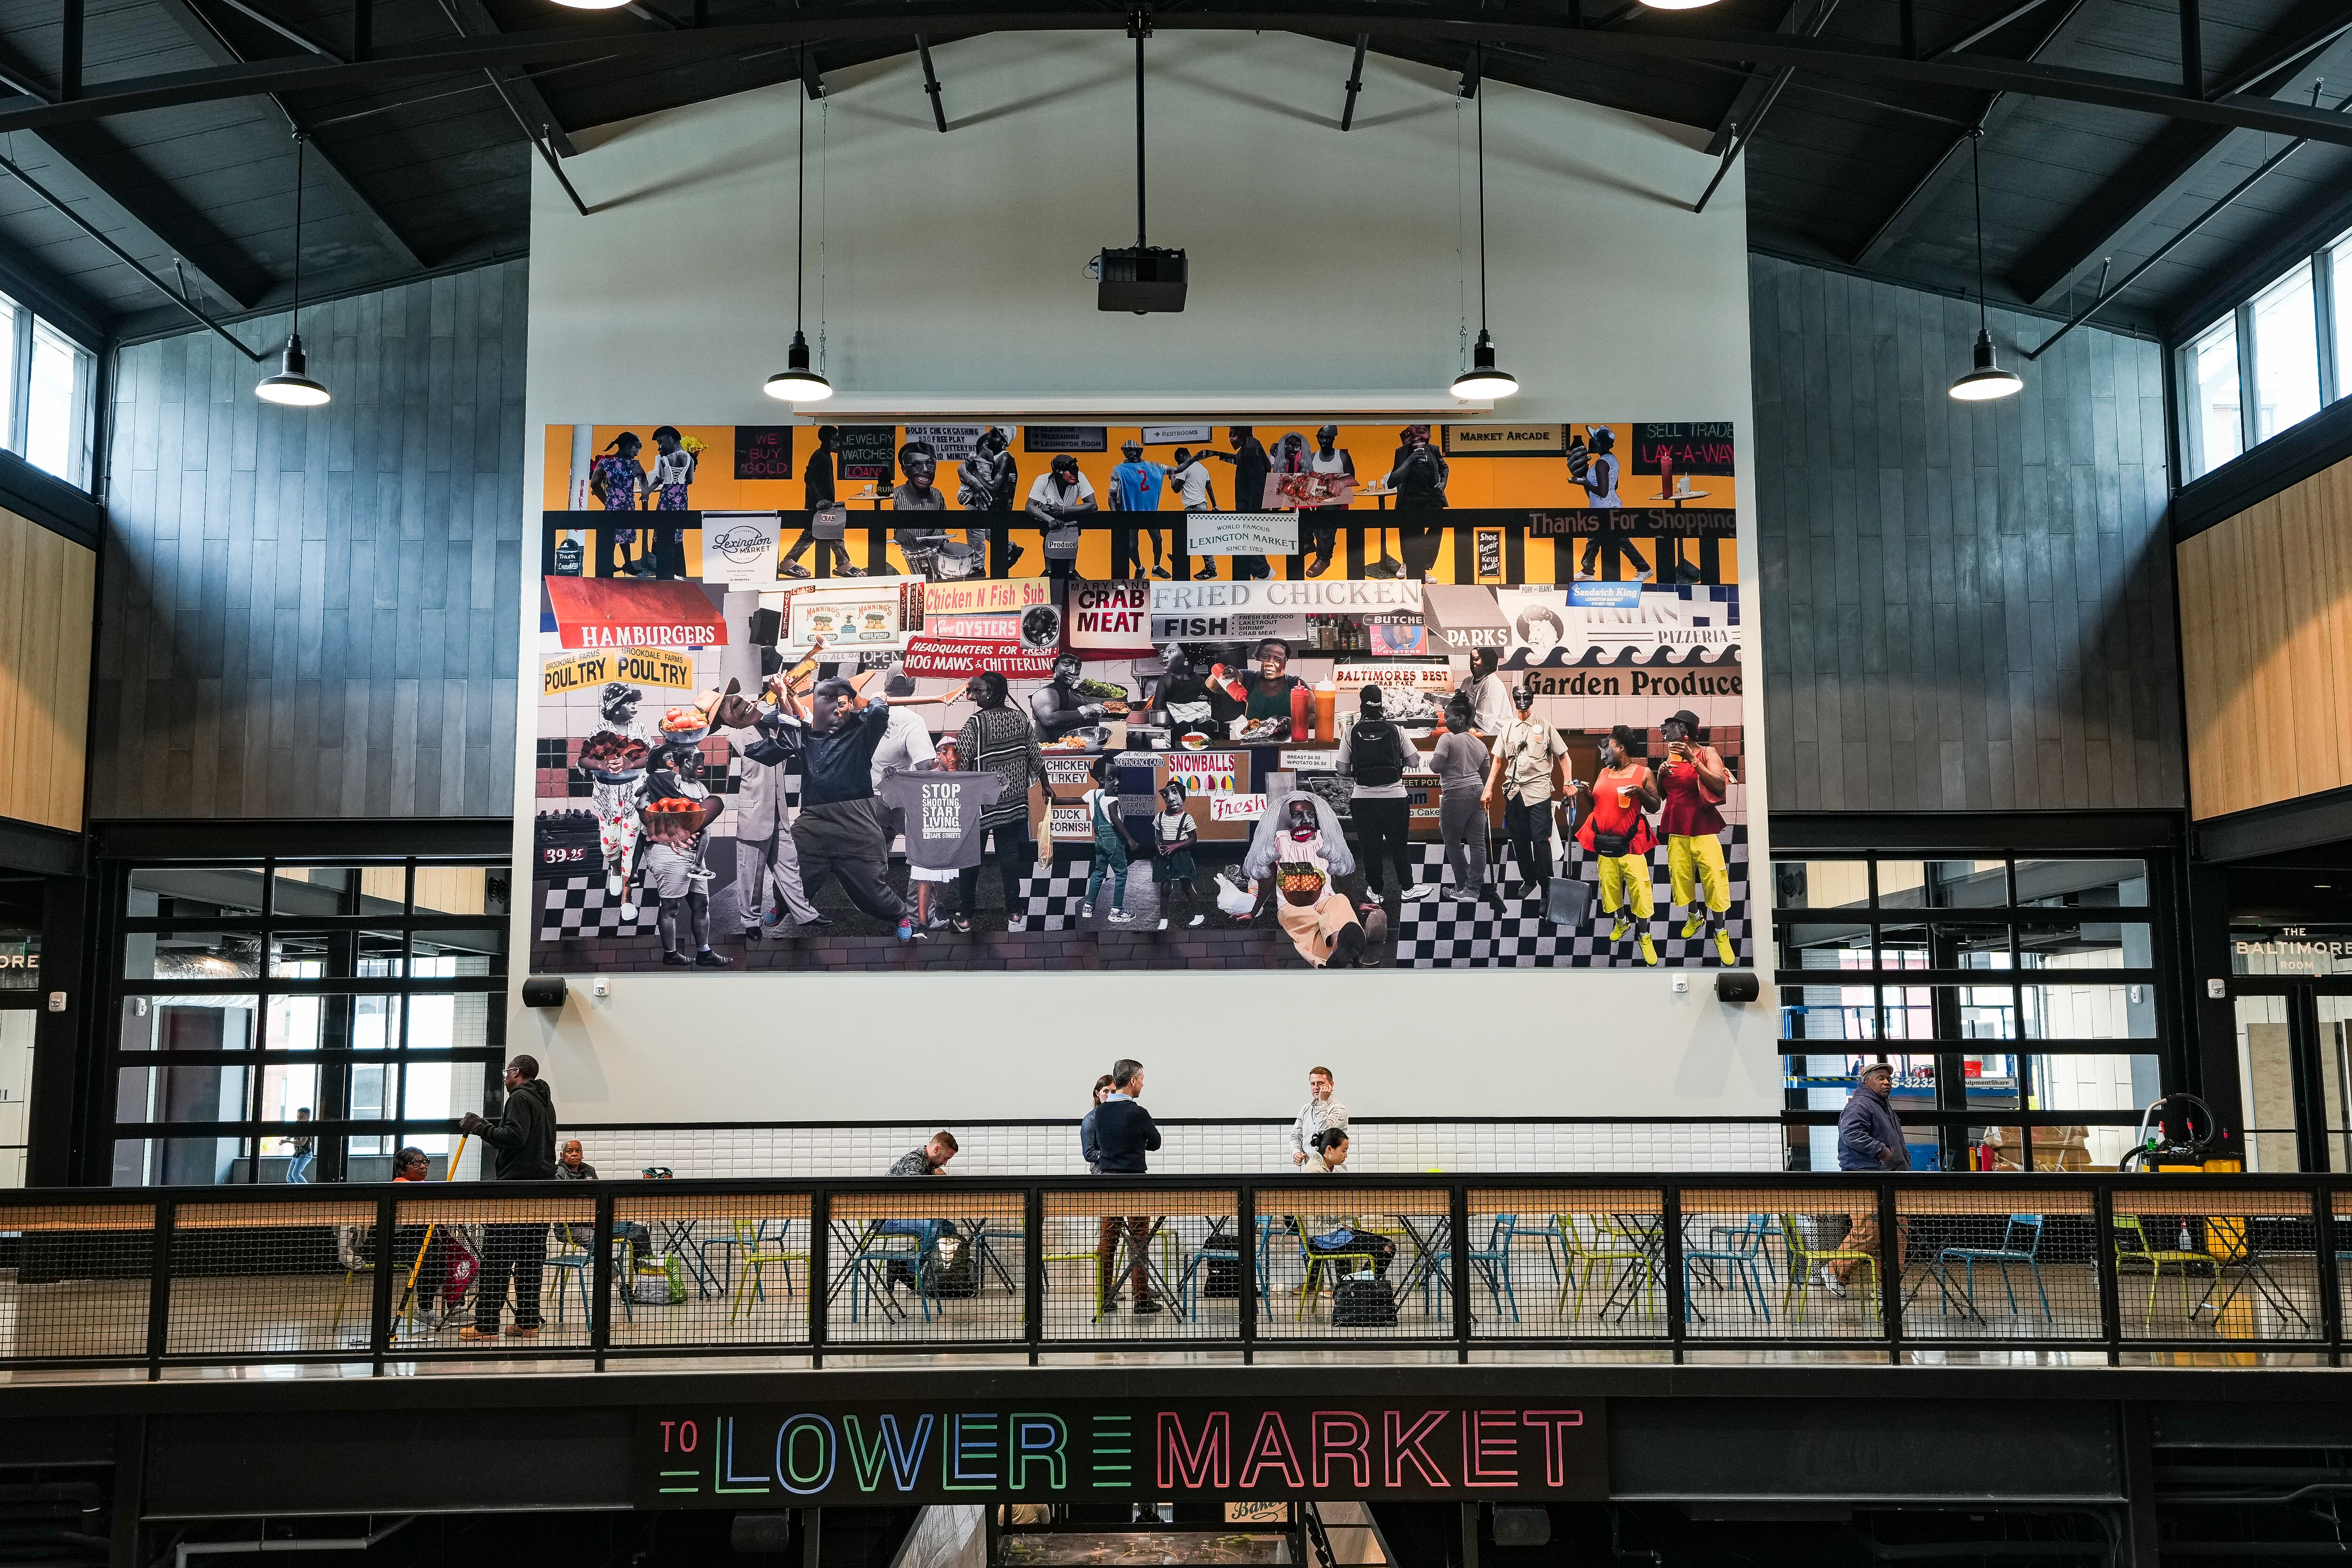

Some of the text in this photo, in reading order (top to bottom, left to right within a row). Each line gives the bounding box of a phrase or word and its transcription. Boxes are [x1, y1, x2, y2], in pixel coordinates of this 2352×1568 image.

[1460, 430, 1549, 441] MARKET ARCADE
[1647, 423, 1733, 438] SELL TRADE
[756, 434, 777, 445] WE
[843, 434, 895, 445] JEWELRY
[750, 448, 782, 459] BUY
[842, 448, 894, 460] WATCHES
[745, 463, 787, 474] GOLD
[848, 467, 882, 478] LOAN
[1137, 469, 1149, 492] 2
[1530, 511, 1599, 534] Thanks
[1610, 509, 1638, 530] For
[712, 533, 772, 553] Lexington
[1189, 533, 1297, 550] LEXINGTON MARKET
[1479, 541, 1498, 553] Repair
[1482, 556, 1499, 565] Keys
[792, 586, 814, 595] CLAMS
[1071, 581, 1150, 591] MARYLAND
[1574, 588, 1637, 598] Sandwich King
[926, 583, 1044, 611] Chicken N Fish Sub
[1078, 589, 1145, 609] CRAB
[1153, 581, 1421, 611] FRIED CHICKEN
[782, 592, 790, 637] OYSTERS
[806, 606, 840, 621] MANNING'S
[857, 604, 892, 619] MANNING'S
[956, 620, 1017, 636] OYSTERS
[1077, 612, 1145, 633] MEAT
[1164, 617, 1228, 637] FISH
[580, 624, 715, 647] HAMBURGERS
[1446, 629, 1509, 648] PARKS
[1658, 630, 1729, 644] PIZZERIA
[621, 647, 683, 663] BROOKDALE FARMS
[911, 642, 1017, 655] HEADQUARTERS FOR
[546, 649, 600, 671] BROOKDALE FARMS
[905, 655, 983, 671] HOG MAWS &
[544, 657, 606, 692] POULTRY
[618, 656, 687, 685] POULTRY
[1337, 671, 1447, 681] BALTIMORES BEST
[1525, 670, 1742, 695] Garden Produce
[1046, 761, 1091, 770] CHICKEN
[1169, 754, 1235, 772] SNOWBALLS
[922, 783, 961, 798] STOP
[922, 798, 961, 807] SHOOTING.
[1212, 794, 1266, 821] Fresh
[922, 806, 961, 817] START
[1053, 810, 1080, 820] DUCK
[923, 817, 961, 827] LIVING.
[1050, 822, 1090, 832] CORNISH
[547, 849, 584, 863] 39.95
[2236, 942, 2352, 955] BALTIMORE
[1891, 1078, 1935, 1088] S-3232
[660, 1420, 698, 1452] TO
[715, 1410, 1583, 1495] LOWER MARKET
